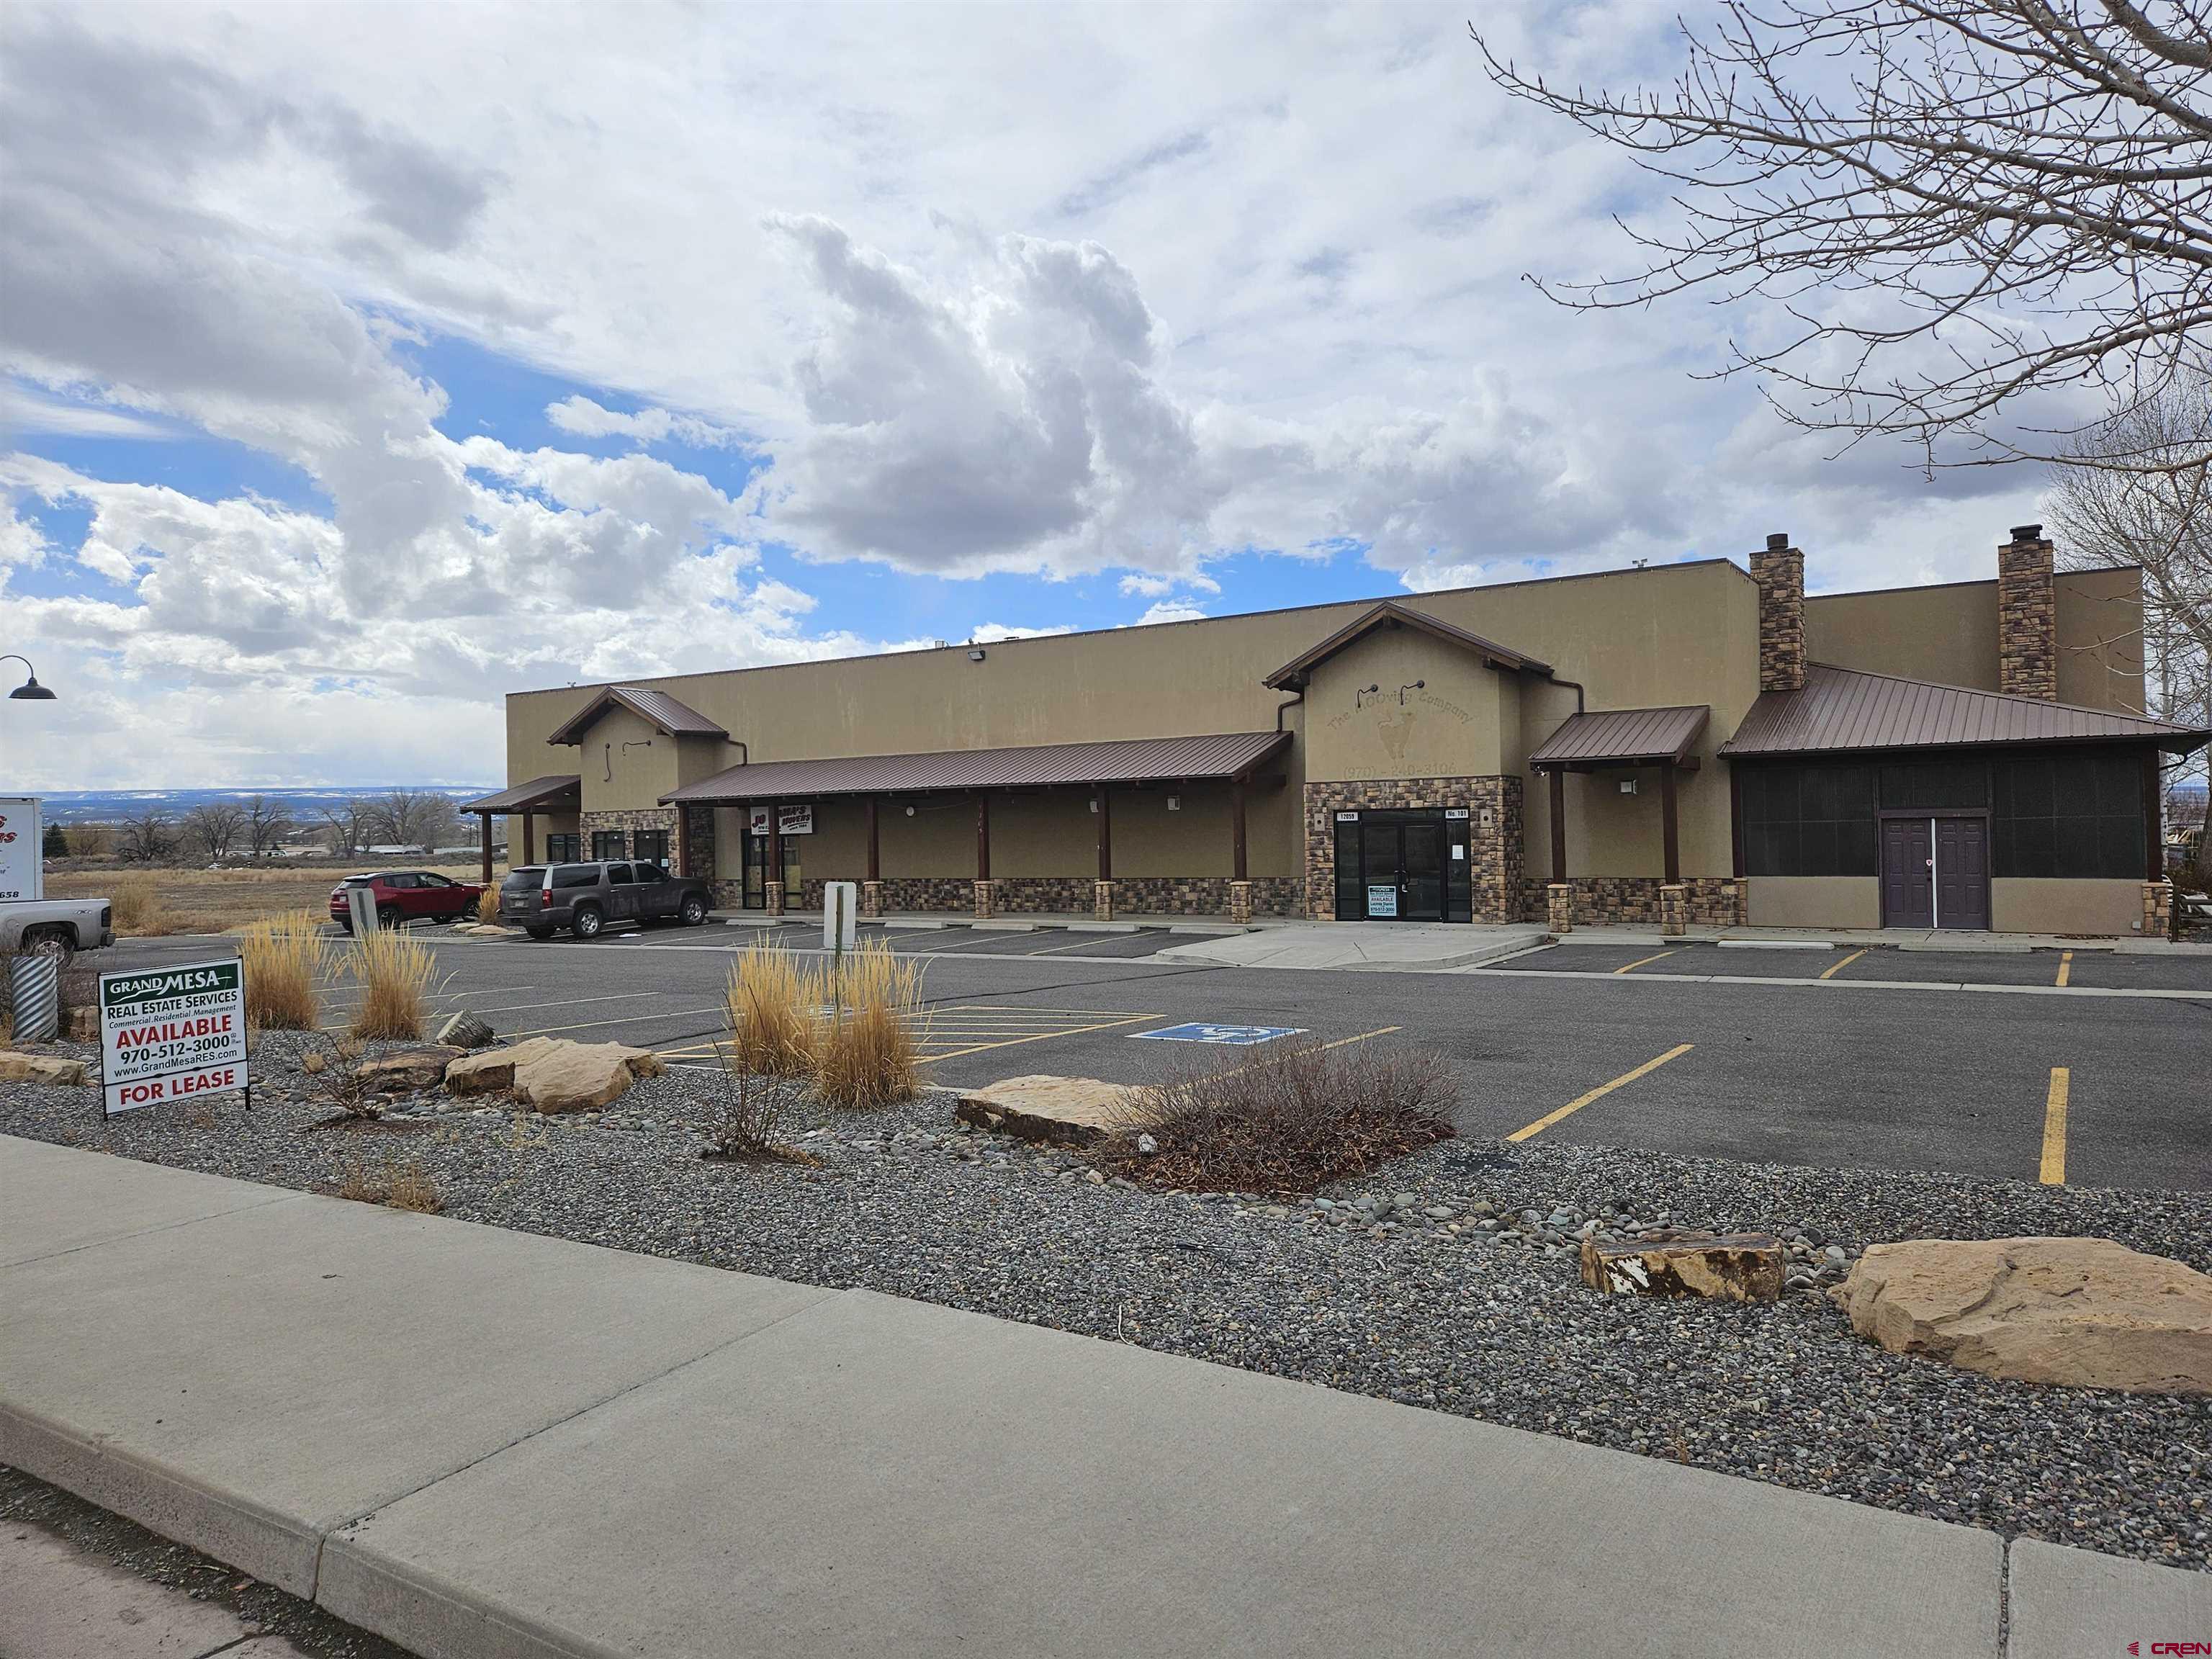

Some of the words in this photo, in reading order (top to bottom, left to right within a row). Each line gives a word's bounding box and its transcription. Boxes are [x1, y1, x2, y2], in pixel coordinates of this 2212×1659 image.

[1327, 712, 1350, 730] The
[1419, 691, 1473, 724] Company
[110, 977, 163, 994] GRAND
[157, 971, 220, 995] MESA
[108, 1004, 138, 1020] REAL
[143, 999, 182, 1015] ESTATE
[186, 991, 238, 1009] SERVICES
[116, 1015, 232, 1049] AVAILABLE
[114, 1048, 237, 1077] www.GrandMesaRES.com
[120, 1035, 230, 1064] 970-512-3000
[120, 1083, 164, 1105] FOR
[172, 1069, 234, 1096] LEASE
